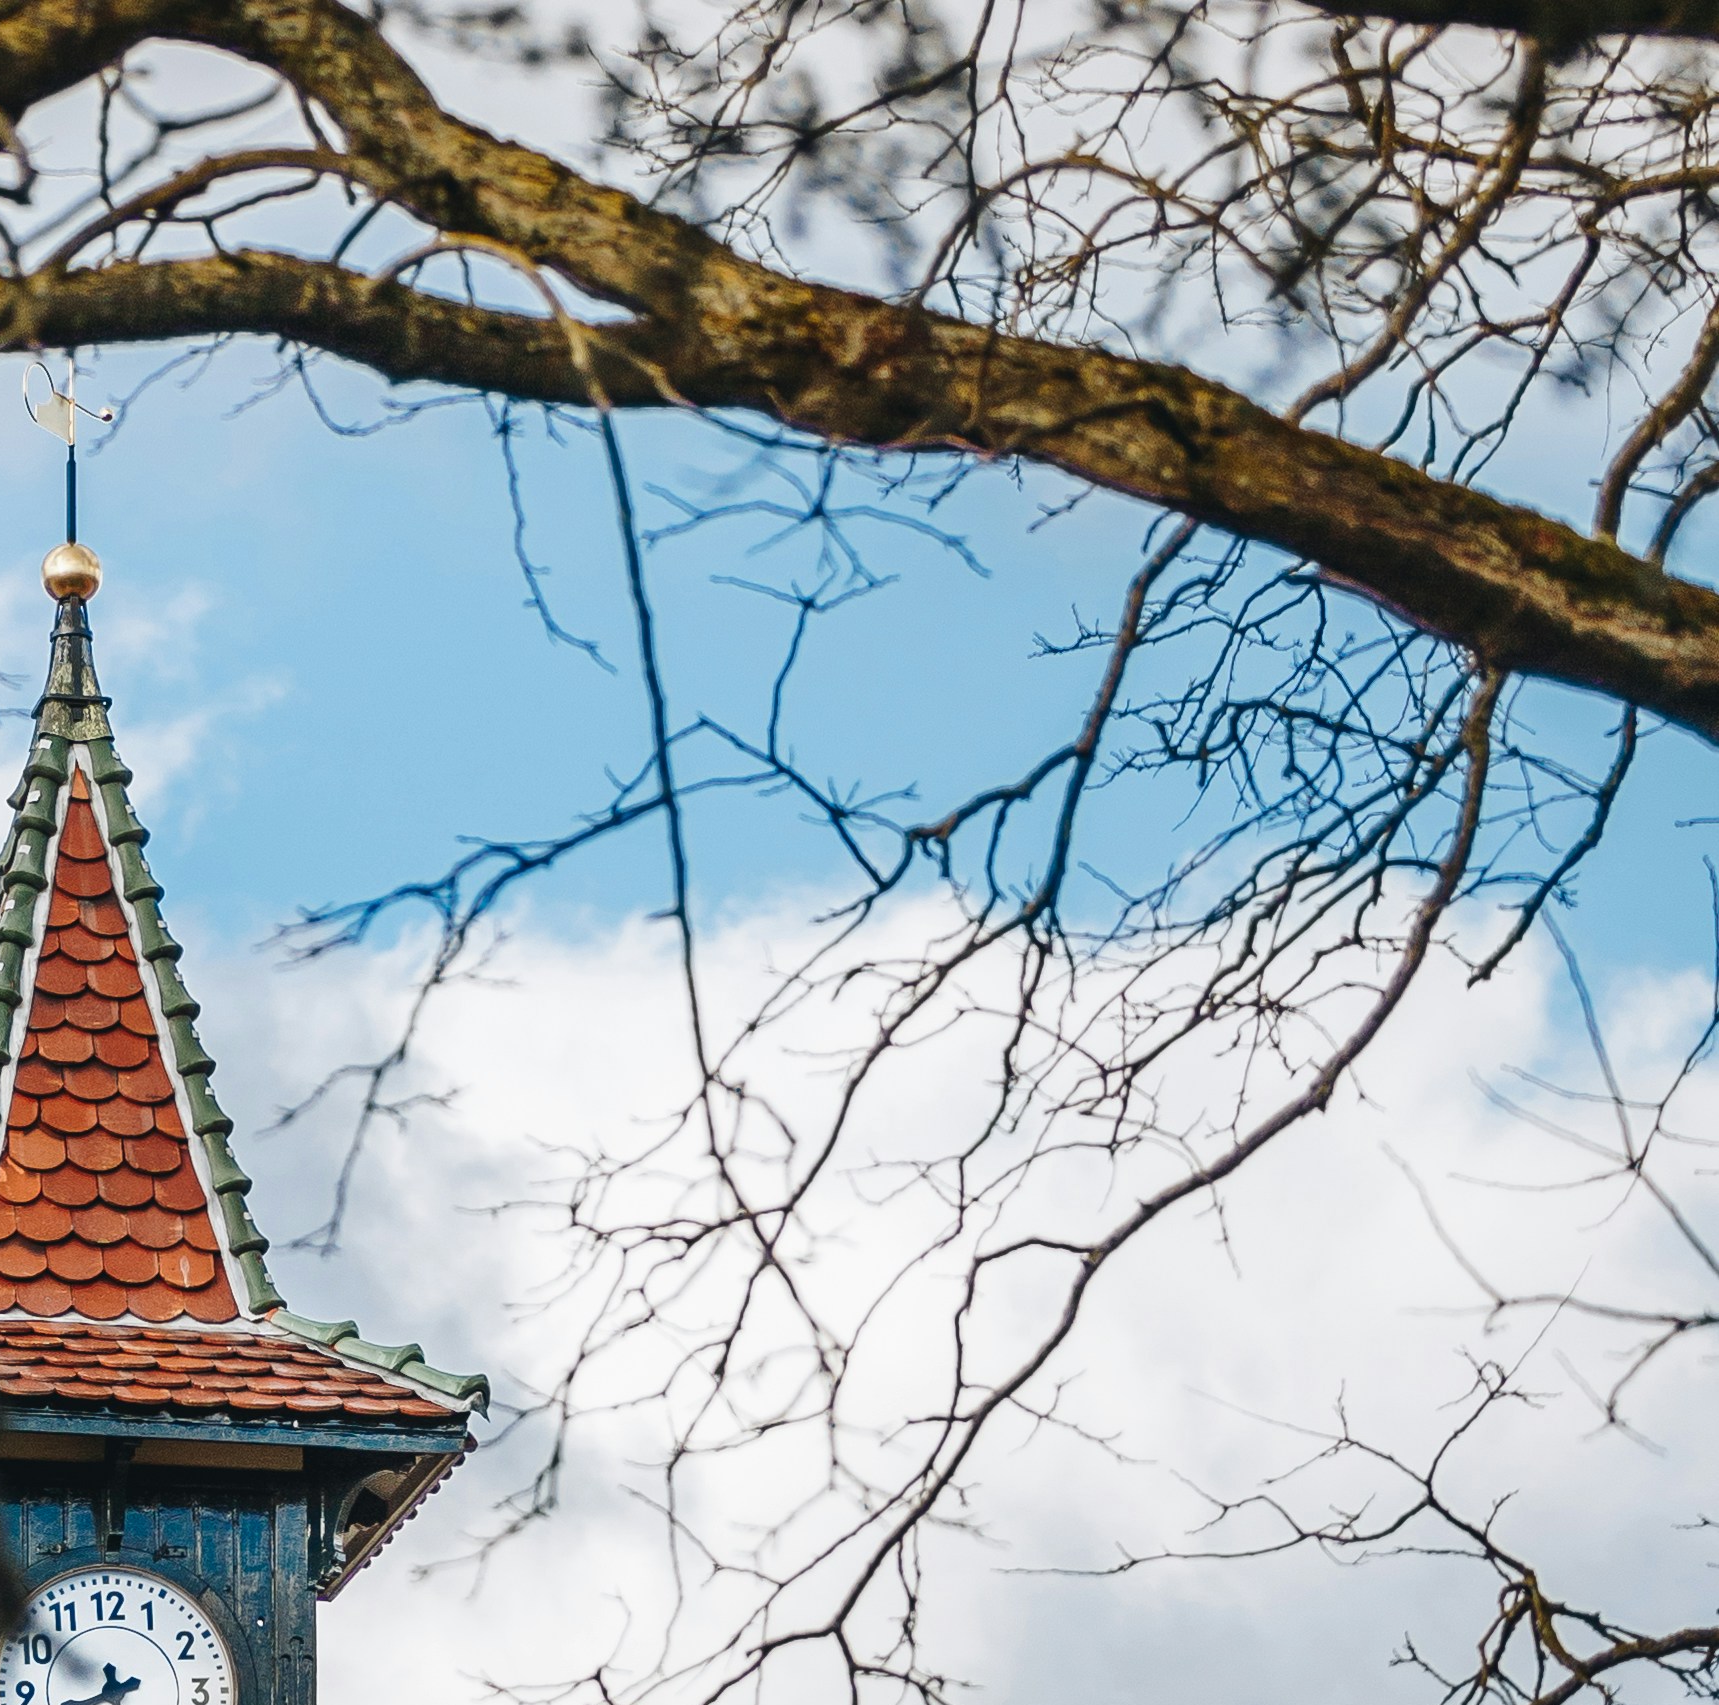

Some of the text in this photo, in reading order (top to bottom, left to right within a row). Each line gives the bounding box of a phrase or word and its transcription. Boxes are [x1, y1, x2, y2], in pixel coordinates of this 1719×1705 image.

[48, 1601, 77, 1632] 11
[90, 1591, 126, 1621] 12
[140, 1600, 154, 1631] 1
[18, 1634, 52, 1665] 10
[175, 1631, 195, 1660] 2
